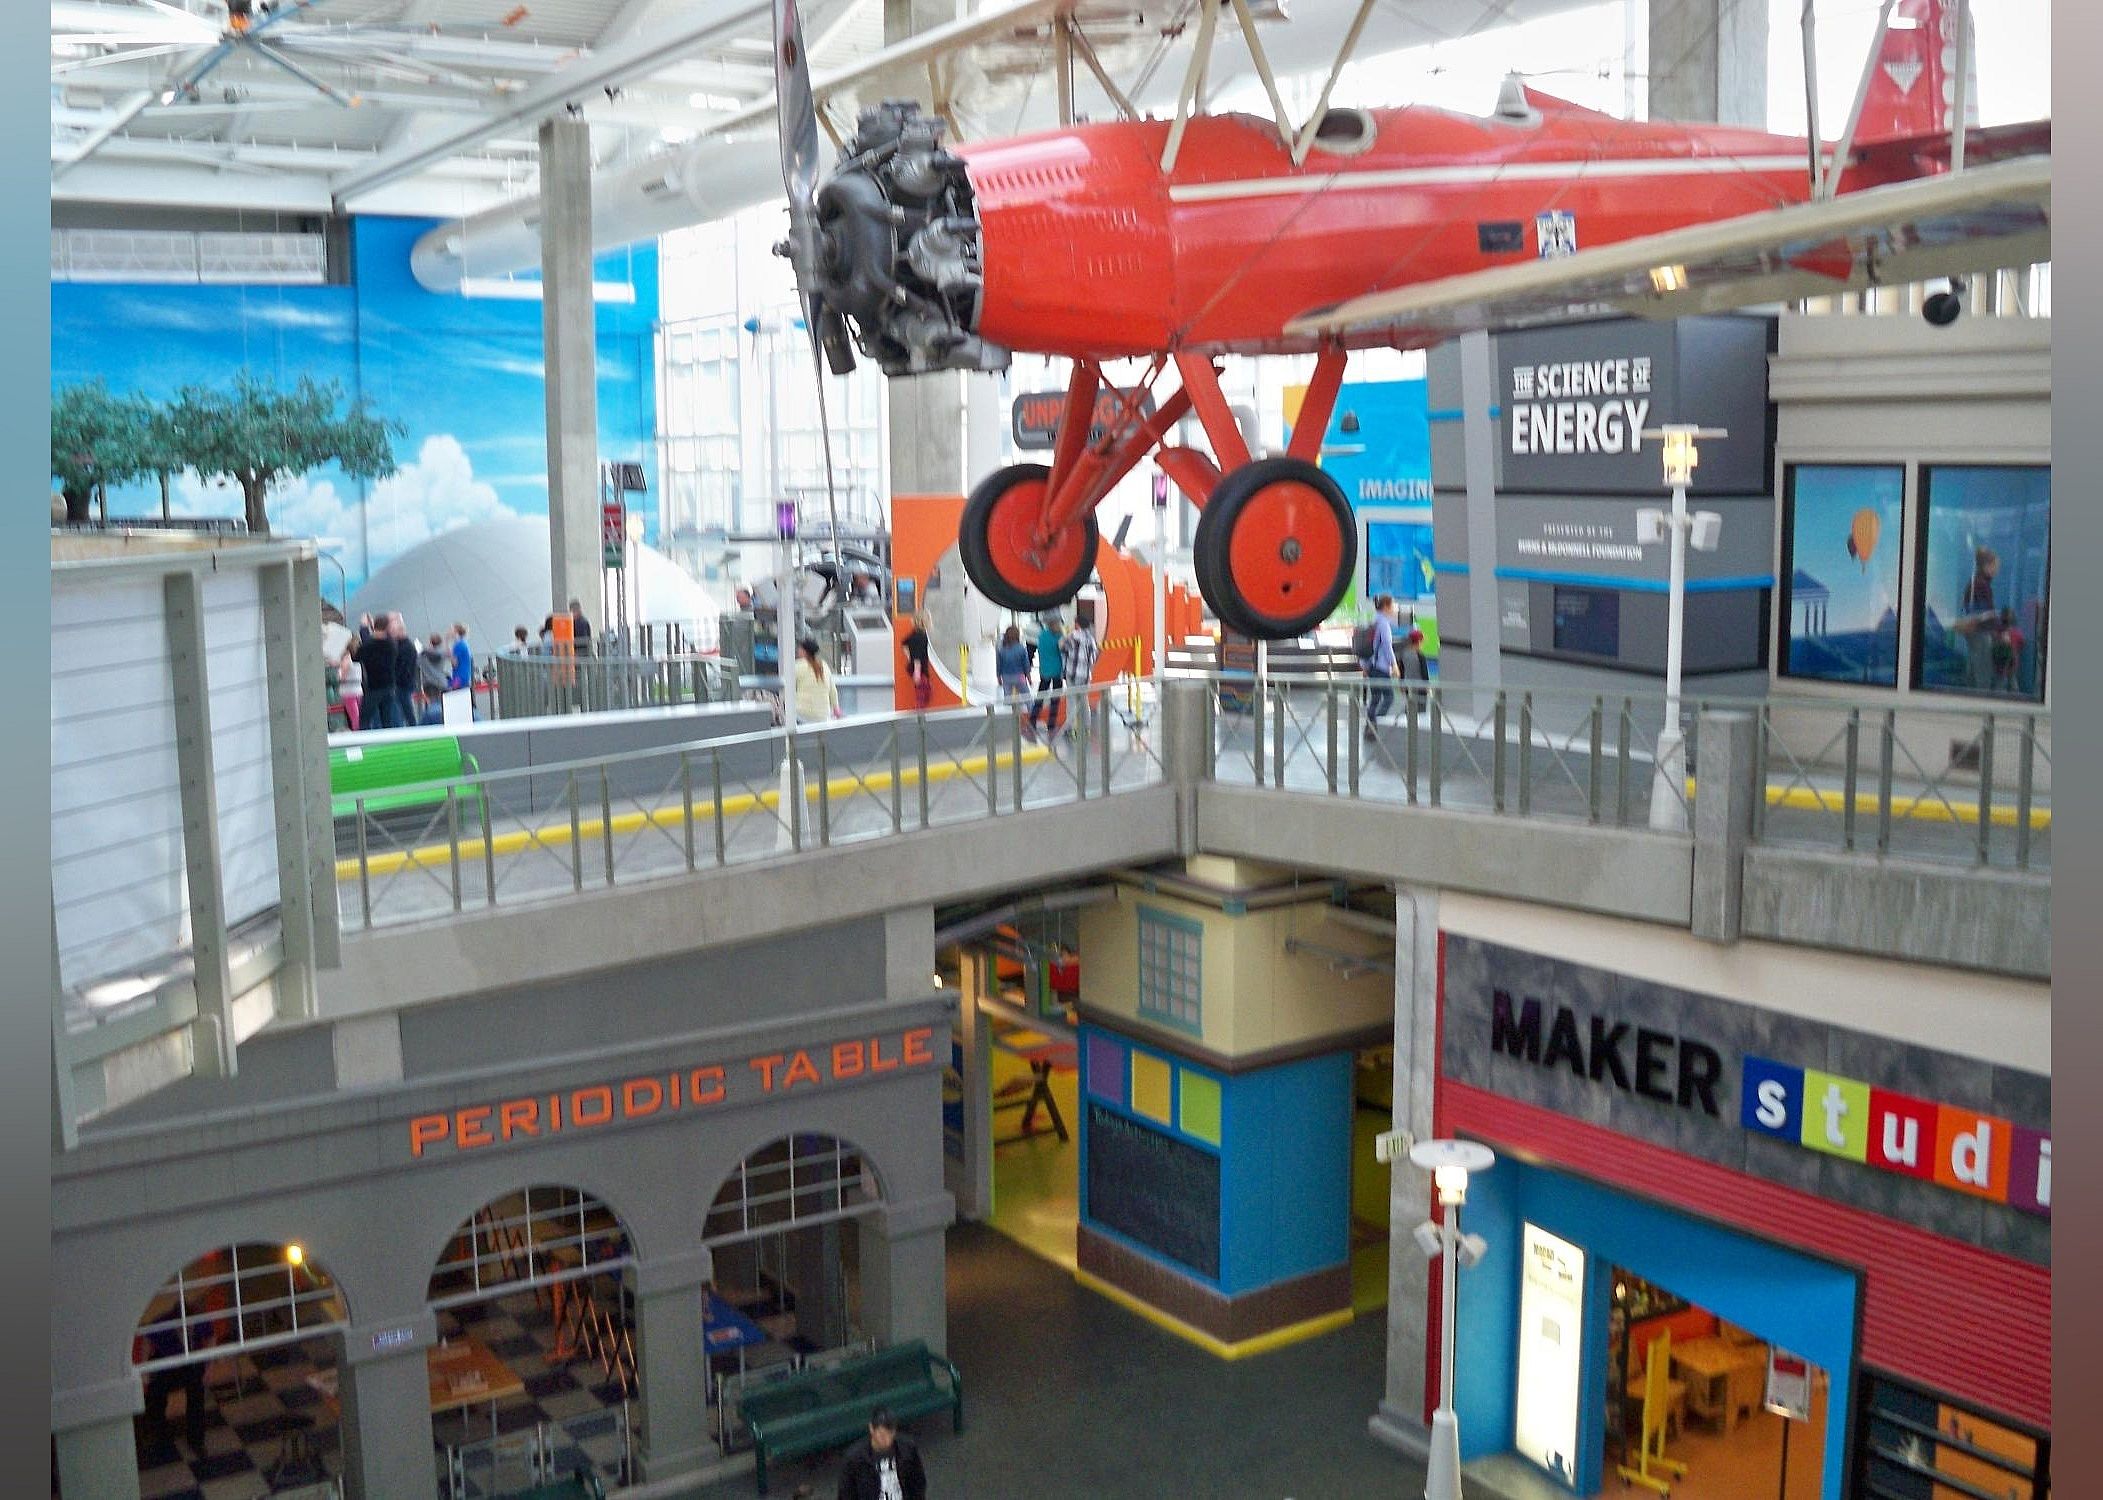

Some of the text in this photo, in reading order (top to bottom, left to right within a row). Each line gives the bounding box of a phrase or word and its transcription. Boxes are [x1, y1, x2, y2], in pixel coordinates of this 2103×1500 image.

[1537, 358, 1630, 399] SCIENCE
[1512, 398, 1649, 455] ENERGY
[1358, 477, 1434, 501] IMAGIN
[1491, 987, 1722, 1119] MAKER
[409, 1026, 935, 1159] PERIODIC TABLE
